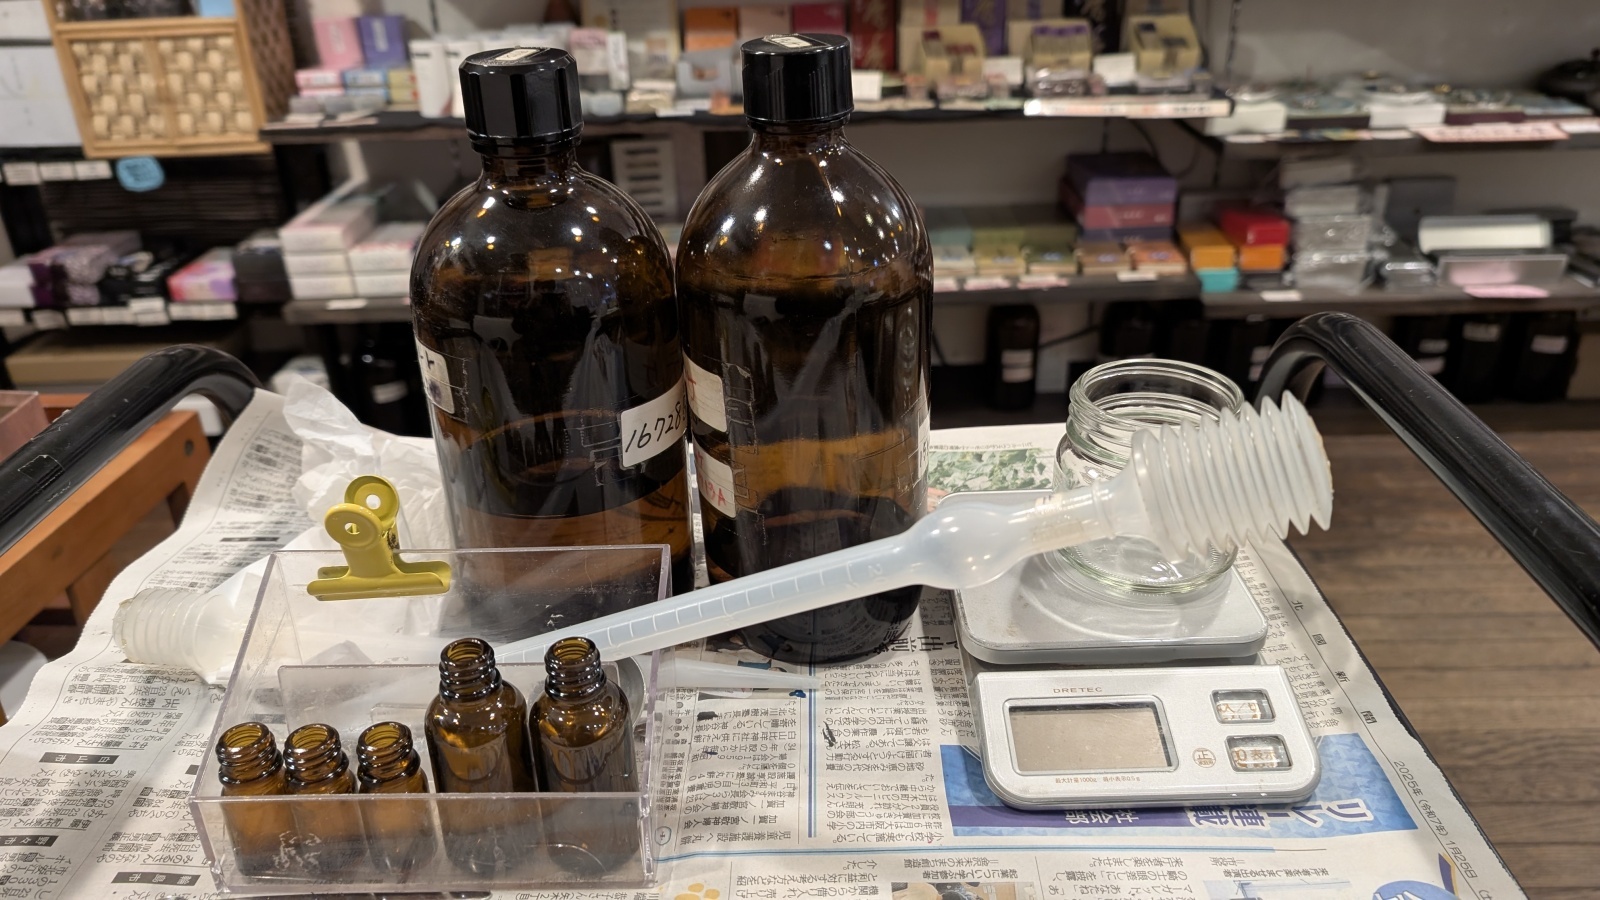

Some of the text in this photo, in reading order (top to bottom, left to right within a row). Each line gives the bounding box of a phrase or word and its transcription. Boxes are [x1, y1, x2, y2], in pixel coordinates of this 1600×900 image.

[53, 752, 112, 765] 白山市
[683, 813, 778, 830] 加賀一ノ宮敬神婦人会
[1063, 809, 1139, 825] 社会部
[831, 831, 945, 845] 小学校でも実施している。
[842, 859, 878, 871] 介した。
[1089, 857, 1184, 868] 来庁者を楽しませた。
[127, 872, 192, 886] 輪島市
[922, 867, 1018, 880] 起業について学ぶ参加者
[1223, 866, 1330, 879] 来庁者を楽しませる出演者
[736, 872, 878, 887] と利益に対する考え方などを紹
